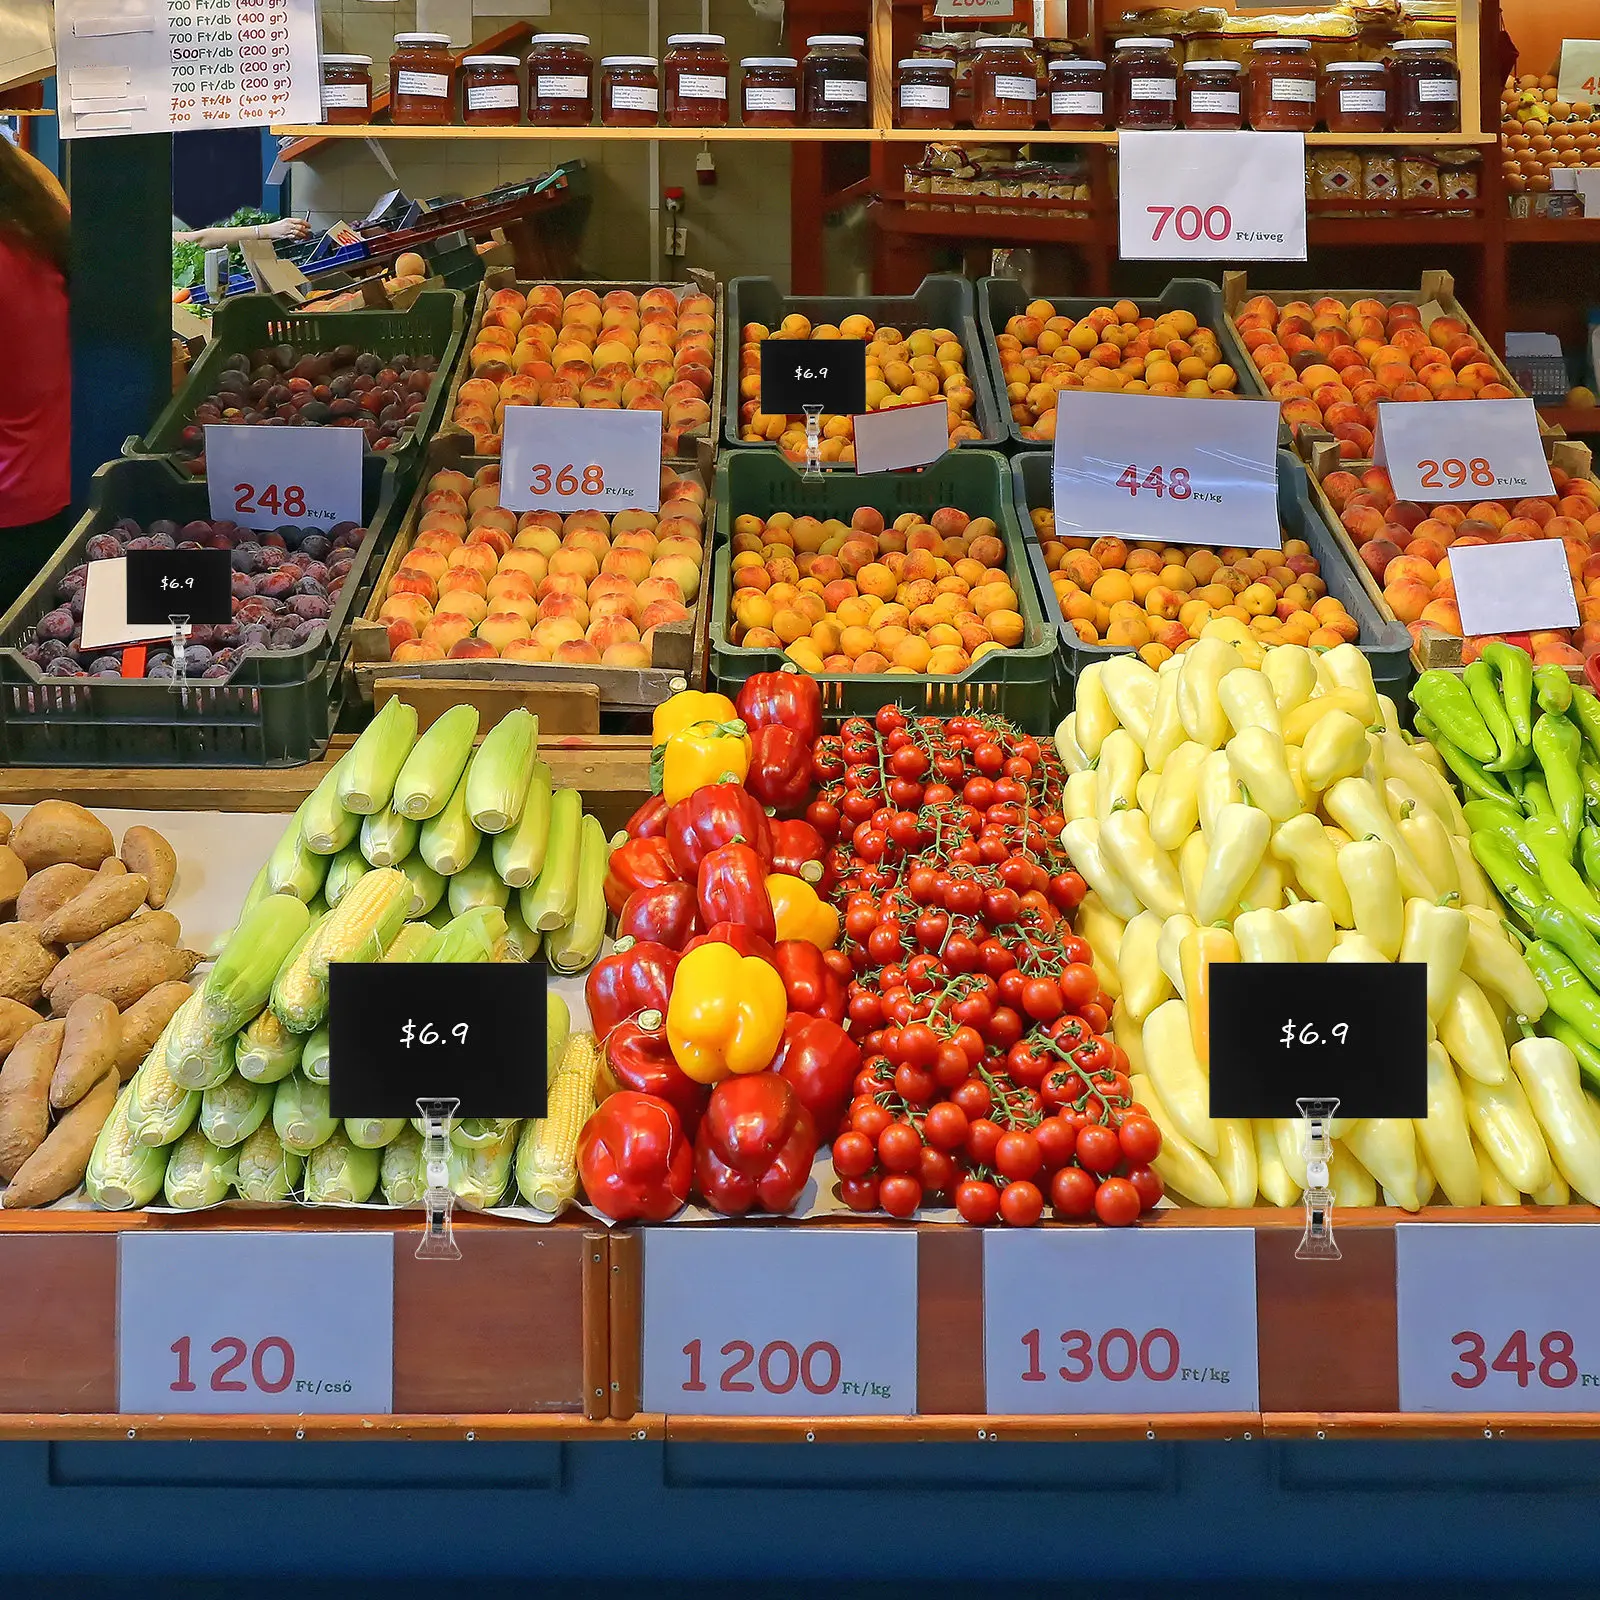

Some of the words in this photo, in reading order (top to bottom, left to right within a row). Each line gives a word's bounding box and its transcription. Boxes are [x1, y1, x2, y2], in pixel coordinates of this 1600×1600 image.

[167, 1, 191, 11] 700
[196, 0, 230, 10] Ft/db
[168, 17, 192, 27] 700
[197, 14, 231, 26] Ft/db
[237, 12, 265, 26] (400
[269, 11, 288, 25] gr)
[169, 33, 192, 44] 700
[198, 31, 232, 42] Ft/db
[238, 28, 266, 42] (400
[271, 28, 289, 42] gr)
[172, 49, 198, 60] 500
[239, 45, 267, 58] (200
[271, 44, 290, 58] gr)
[171, 66, 194, 77] 700
[199, 63, 234, 75] Ft/db
[239, 61, 267, 75] (200
[272, 60, 291, 74] gr)
[172, 82, 195, 93] 700
[201, 80, 235, 92] Ft/db
[241, 78, 269, 91] (200
[273, 76, 291, 90] gr)
[169, 113, 191, 124] 700
[202, 110, 231, 120] Ft/db
[239, 108, 263, 120] (400
[268, 106, 286, 118] gr)
[171, 97, 195, 111] 700
[201, 94, 232, 106] Ft/db
[239, 94, 267, 107] (400
[272, 91, 290, 104] gr)
[1147, 205, 1232, 241] 700
[1236, 229, 1284, 243] Ft/üveg
[793, 365, 829, 380] $6.9
[530, 464, 604, 496] 368
[605, 486, 634, 497] Ft/kg
[1116, 465, 1192, 500] 448
[1193, 491, 1222, 504] Ft/kg
[1417, 457, 1495, 489] 298
[1497, 476, 1527, 487] Ft/kg
[234, 483, 306, 517] 248
[307, 508, 337, 520] Ft/kg
[160, 575, 194, 591] $6.9
[399, 1018, 469, 1049] $6.9
[1279, 1018, 1349, 1049] $6.9
[171, 1337, 294, 1392] 120
[682, 1340, 841, 1394] 1200
[842, 1381, 891, 1399] Ft/kg
[1021, 1328, 1180, 1382] 1300
[1181, 1367, 1230, 1384] Ft/kg
[1451, 1330, 1578, 1388] 348
